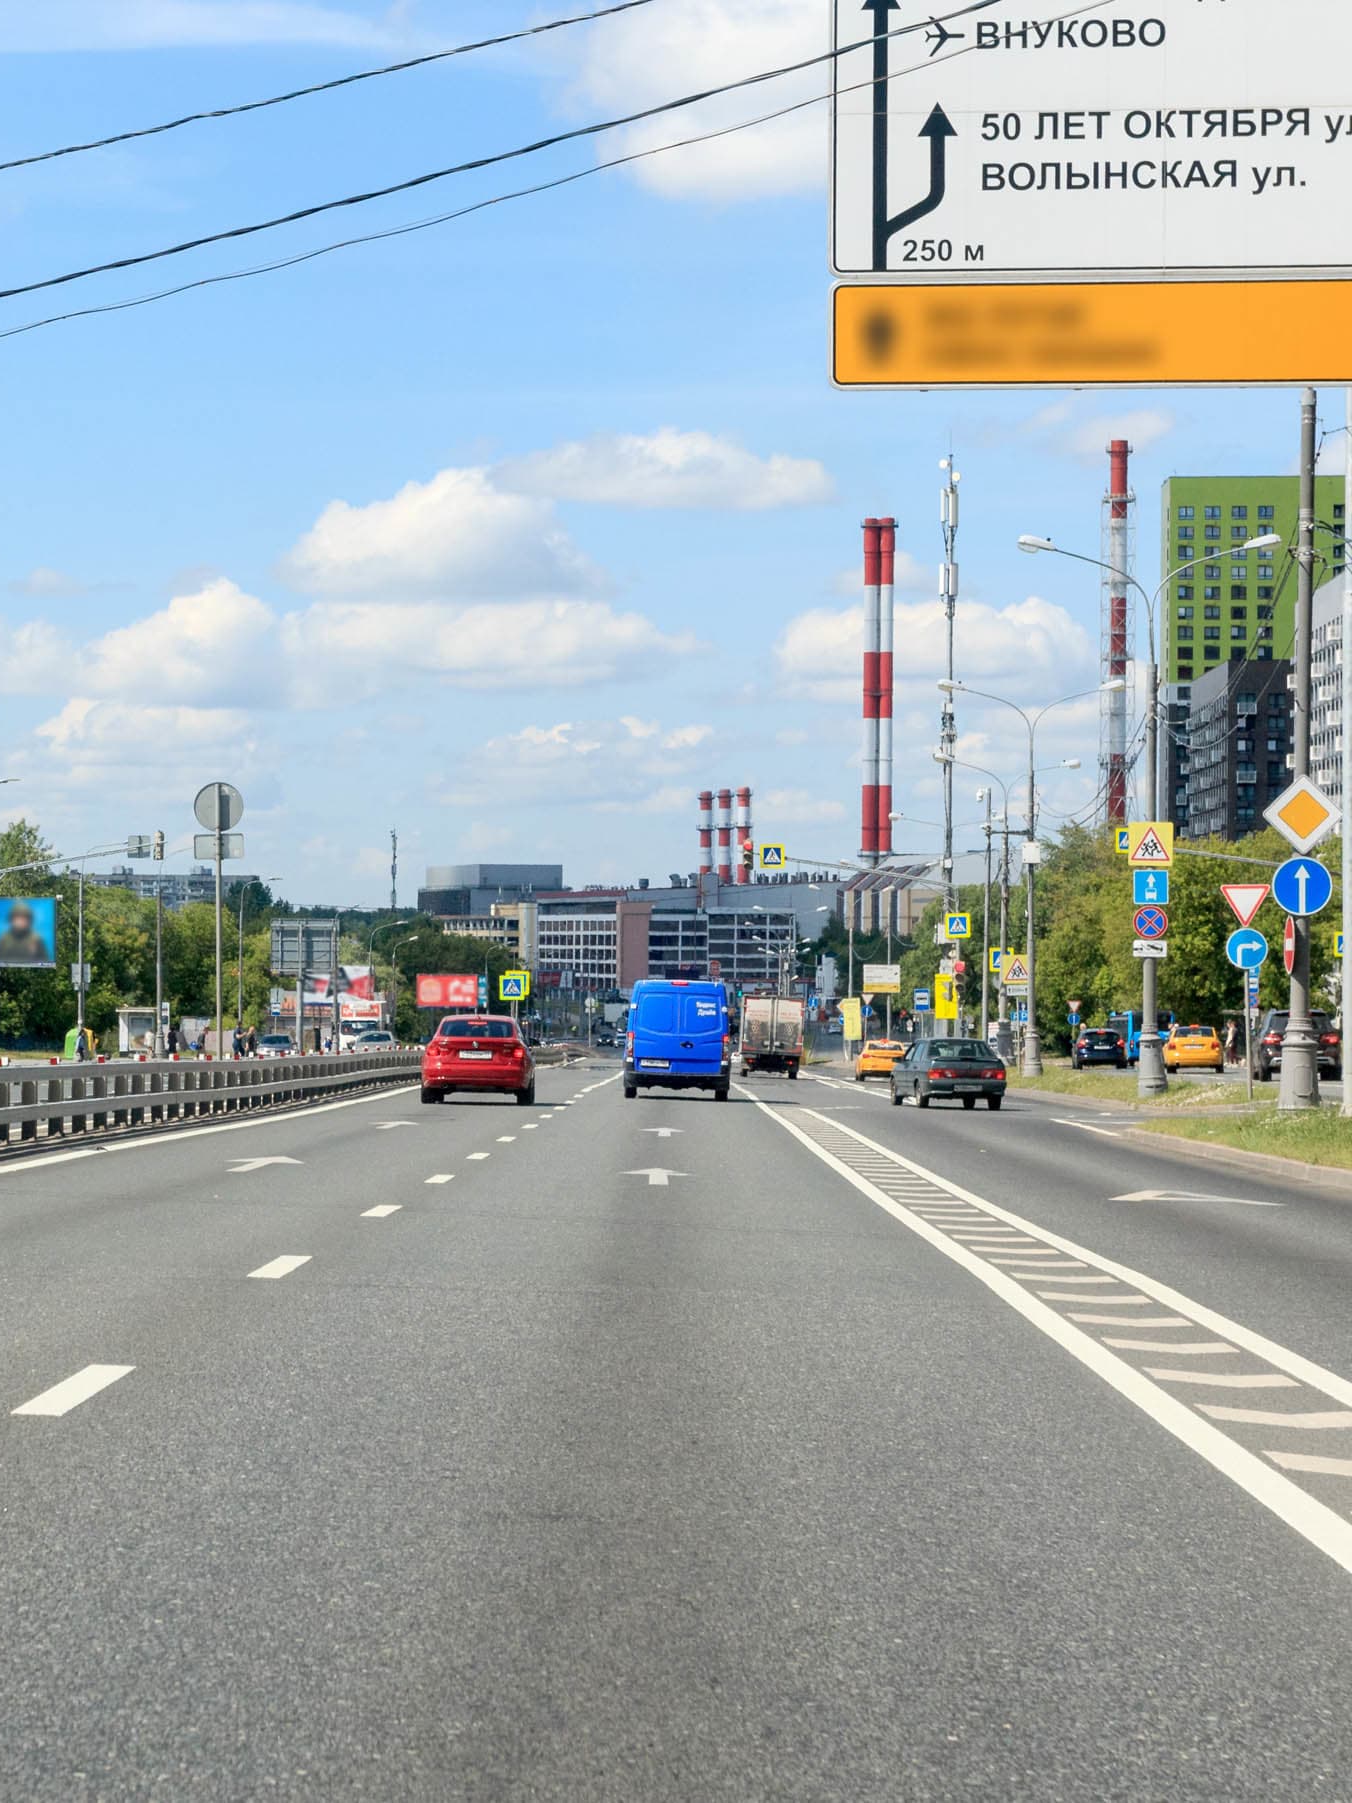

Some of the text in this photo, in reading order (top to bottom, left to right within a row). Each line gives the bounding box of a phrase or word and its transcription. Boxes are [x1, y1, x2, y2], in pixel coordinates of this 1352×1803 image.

[975, 18, 1167, 50] ВНУКОВО
[981, 108, 1352, 144] 50 ЛЕТ ОКТЯБРЯ у
[981, 160, 1307, 195] ВОЛЫНСКАЯ ул.
[902, 239, 985, 263] 250 м
